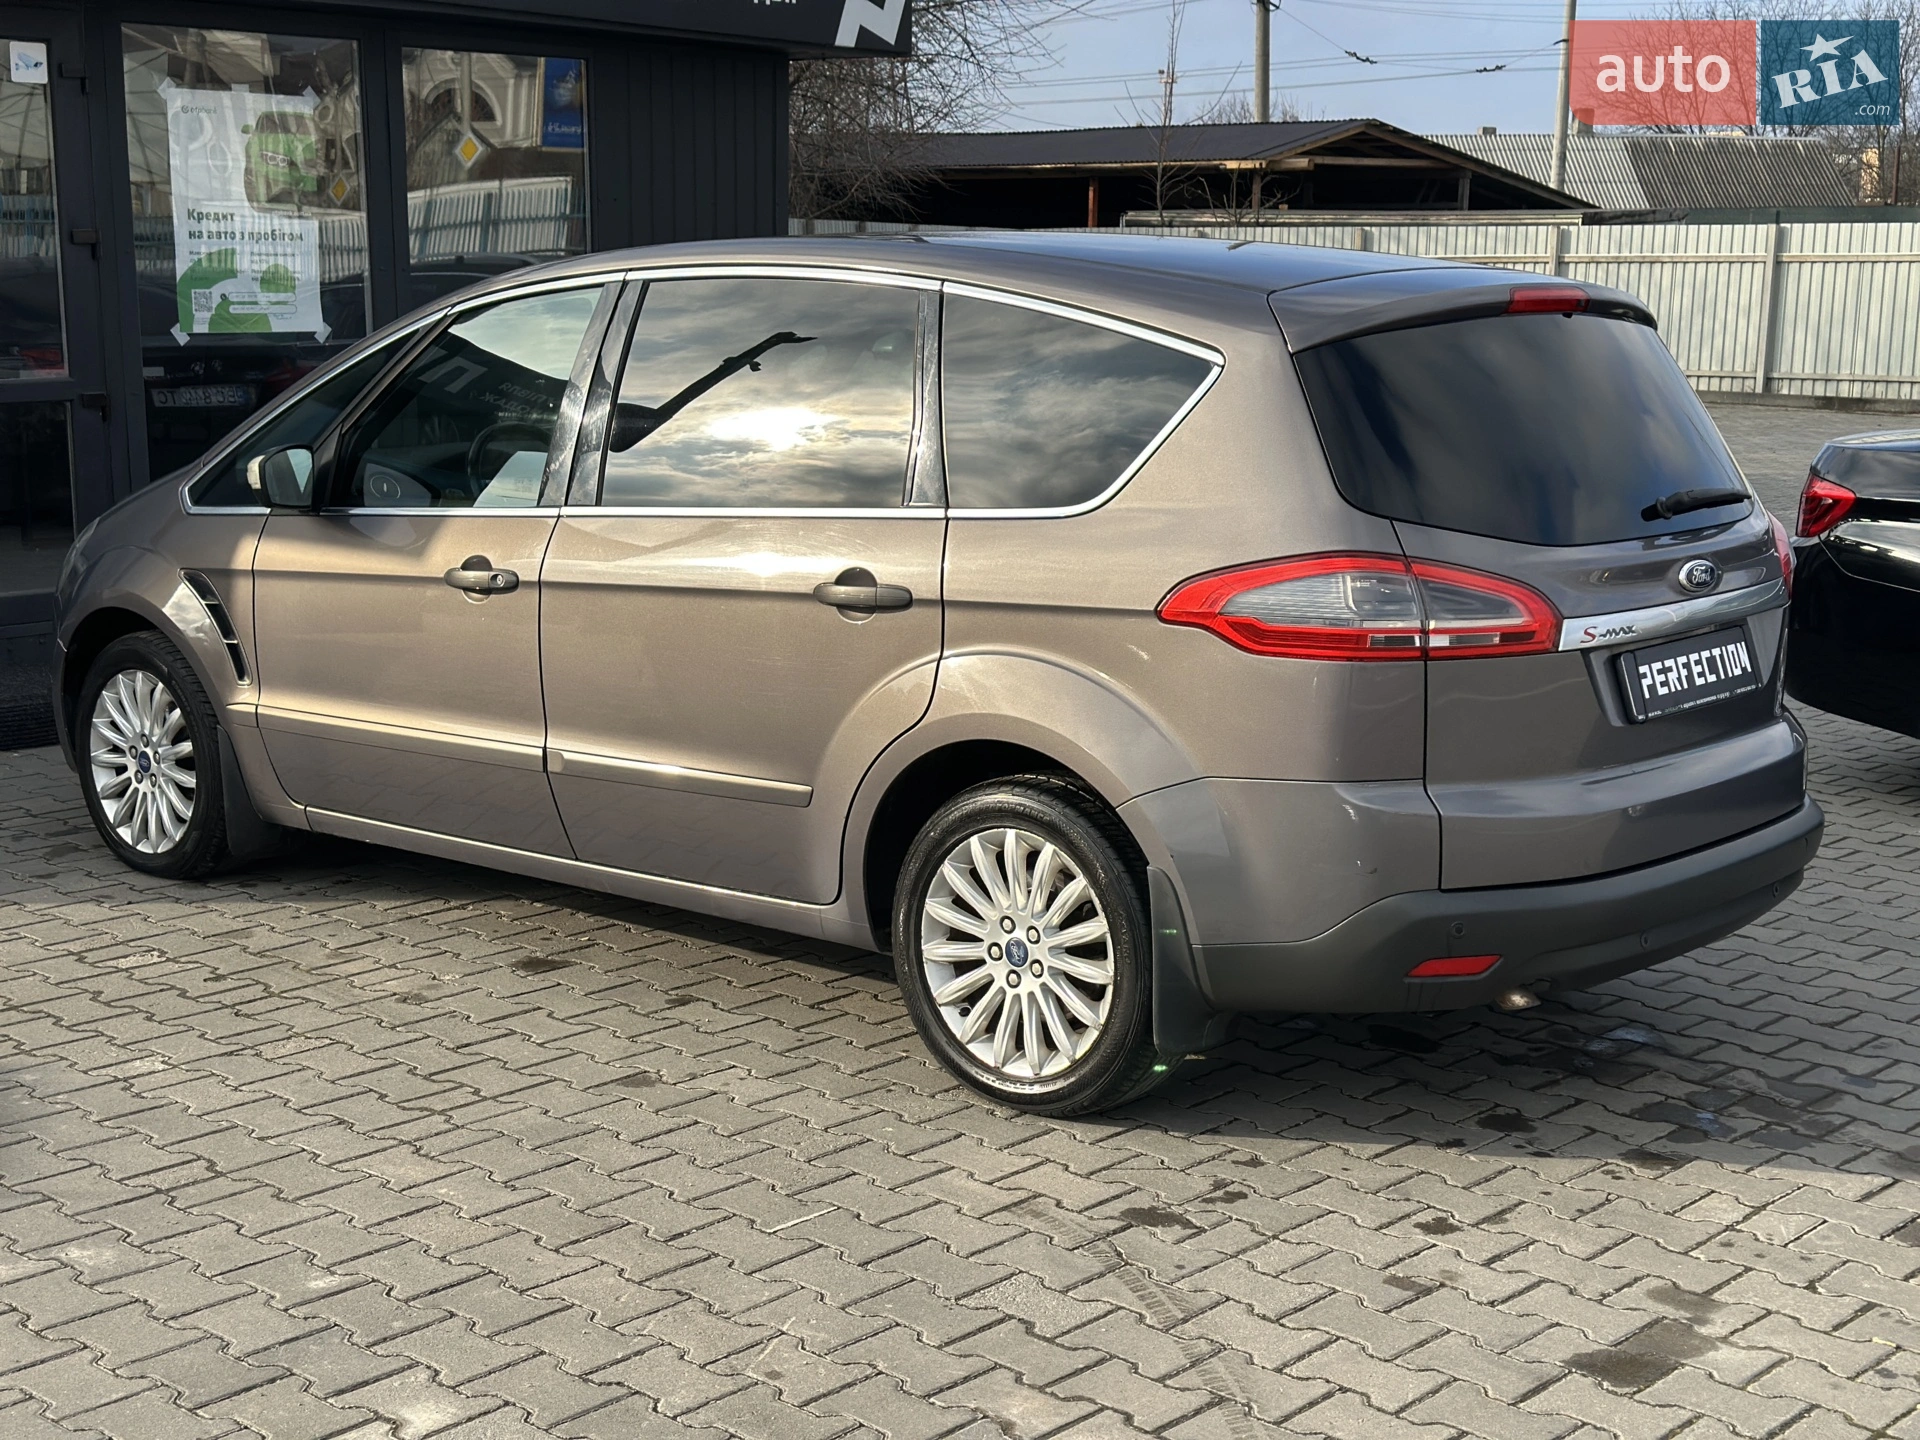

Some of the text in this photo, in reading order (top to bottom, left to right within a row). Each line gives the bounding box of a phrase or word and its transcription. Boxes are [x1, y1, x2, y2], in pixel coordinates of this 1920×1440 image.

[187, 208, 235, 224] Кредит
[188, 228, 304, 244] на авто з пробігом
[1692, 566, 1711, 584] Ford
[1638, 642, 1752, 699] PERFECTION
